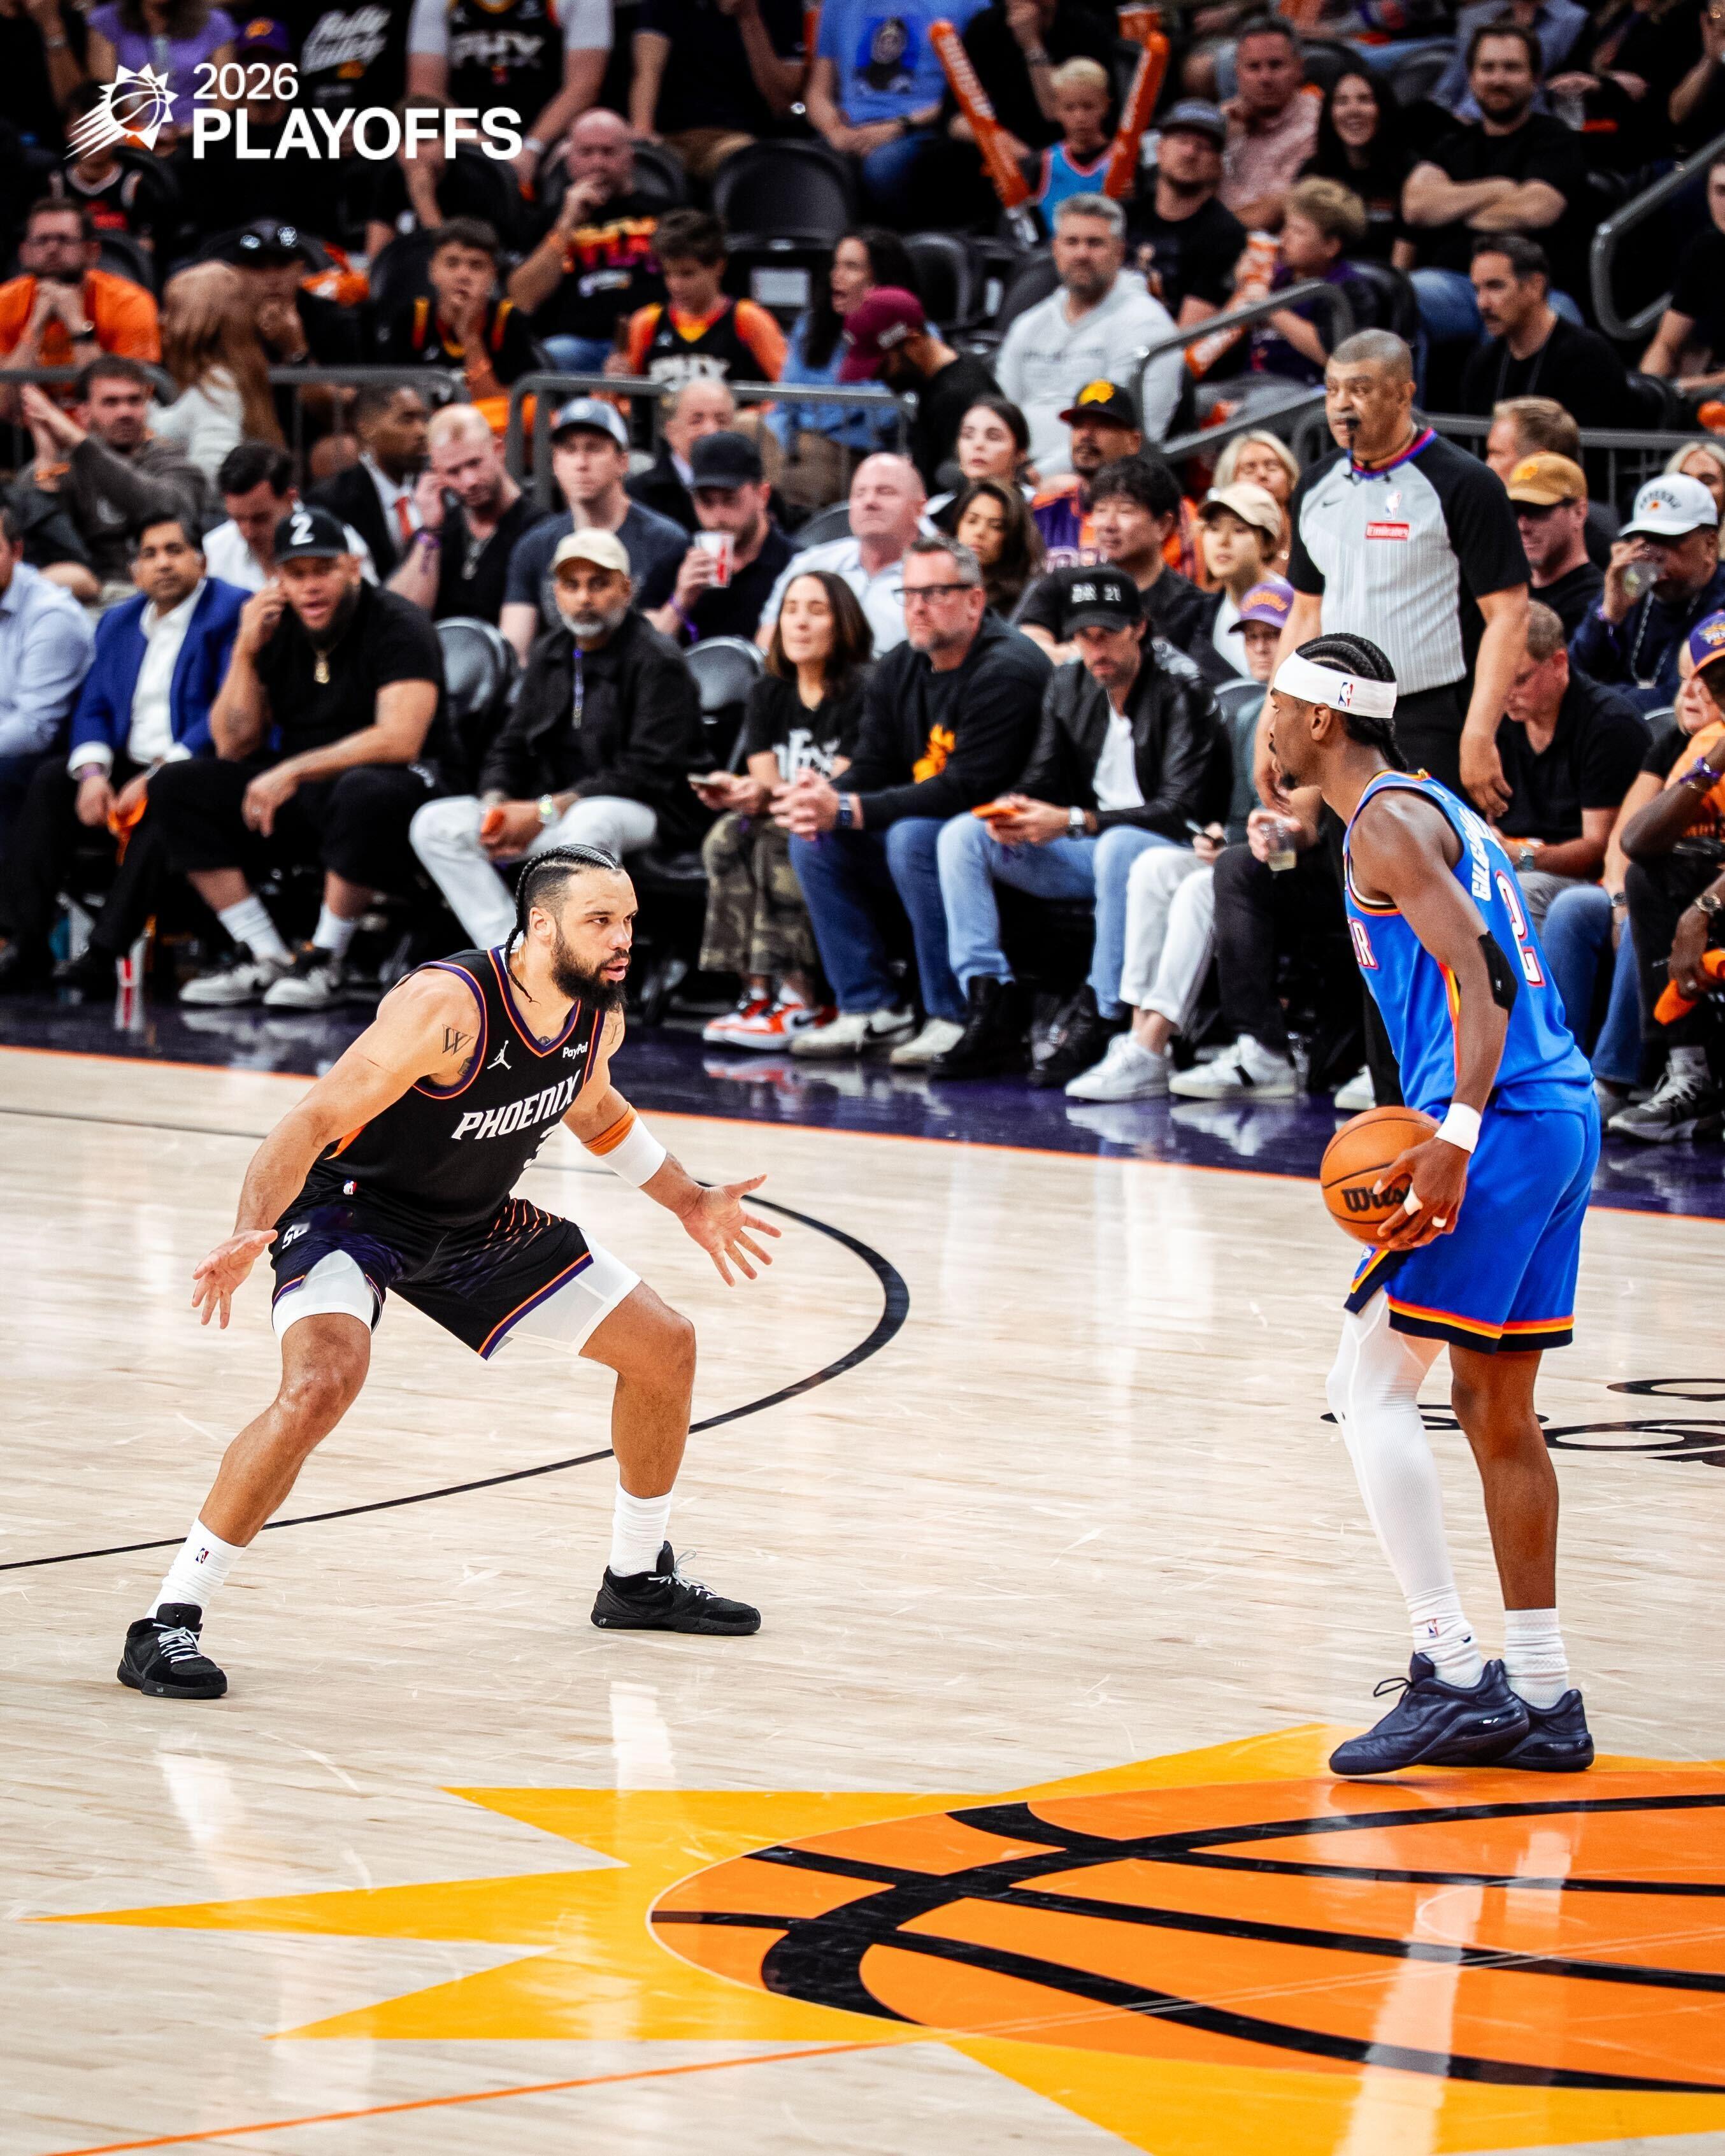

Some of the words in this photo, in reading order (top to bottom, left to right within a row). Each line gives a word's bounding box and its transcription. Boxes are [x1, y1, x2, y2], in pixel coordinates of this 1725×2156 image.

[290, 511, 315, 545] 2
[1494, 870, 1546, 987] 2
[562, 1041, 589, 1060] PayPal
[451, 1069, 580, 1139] PHOENIX
